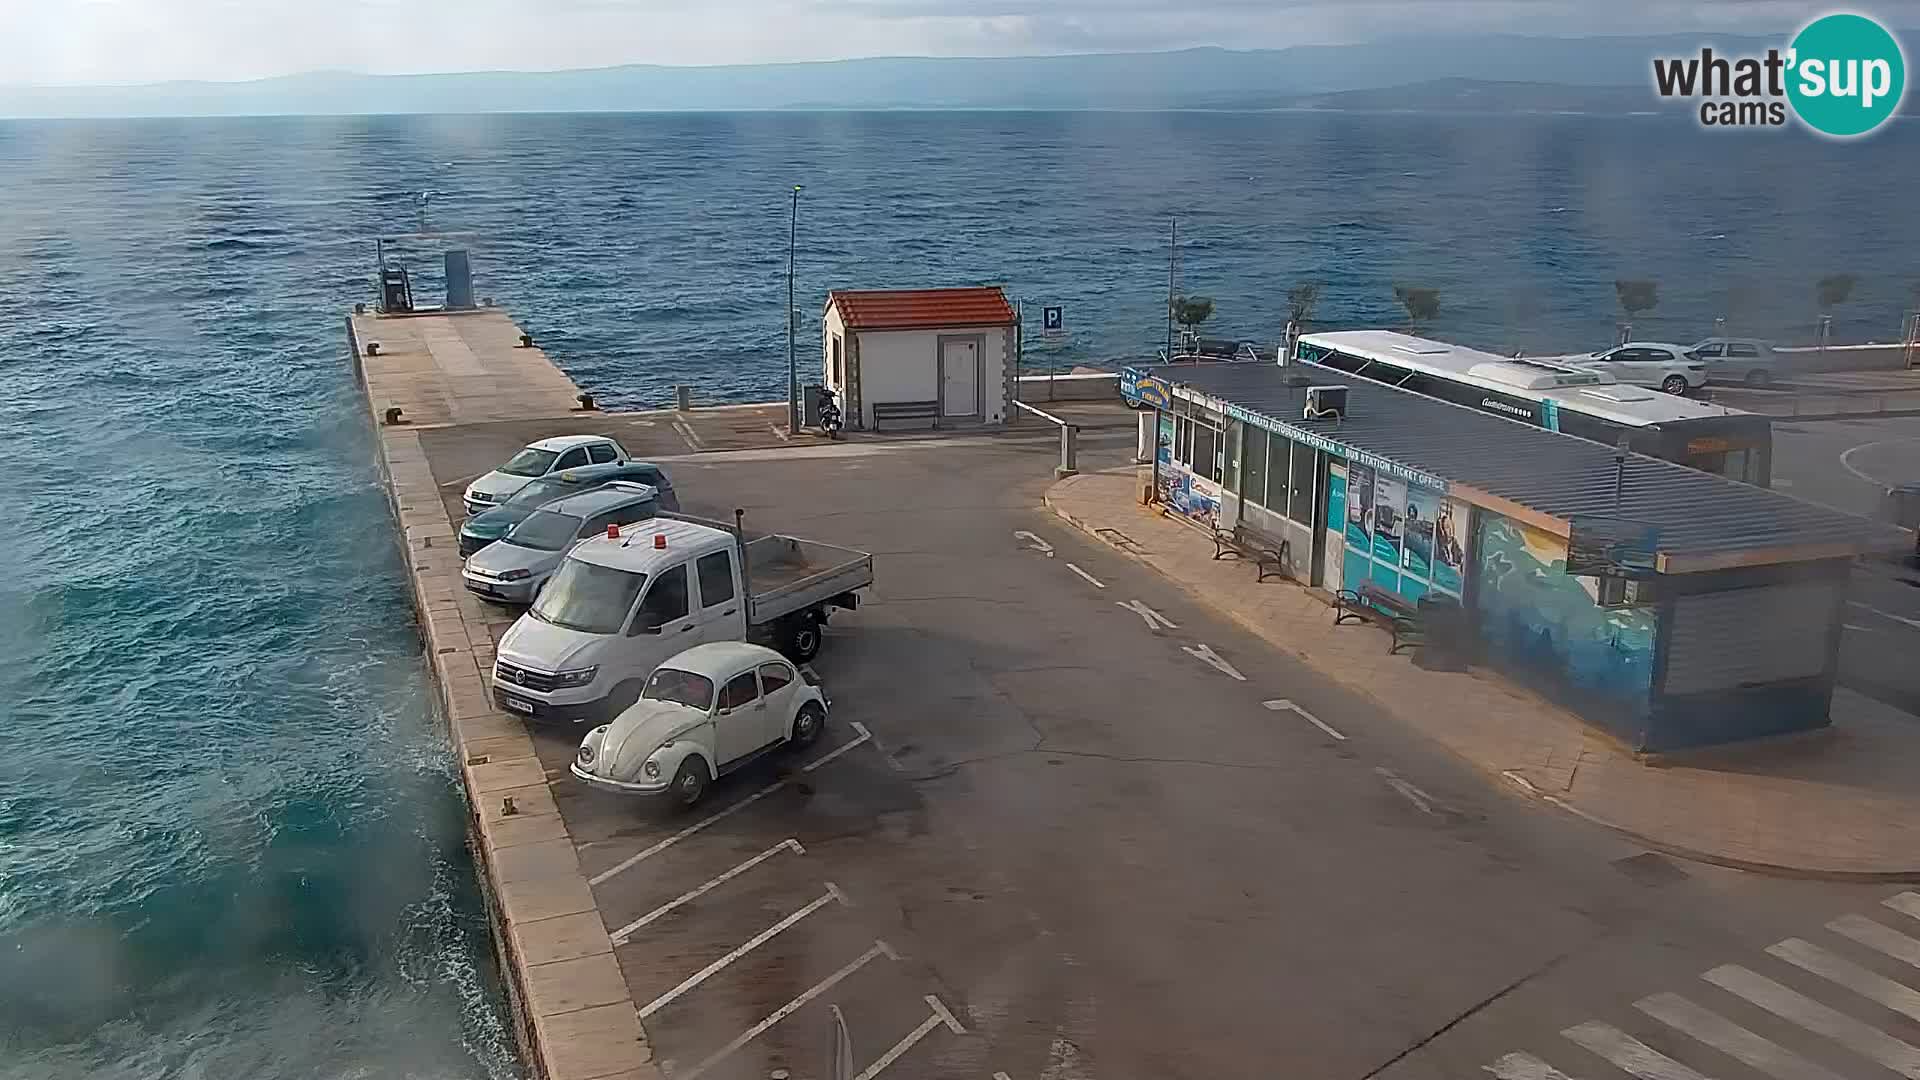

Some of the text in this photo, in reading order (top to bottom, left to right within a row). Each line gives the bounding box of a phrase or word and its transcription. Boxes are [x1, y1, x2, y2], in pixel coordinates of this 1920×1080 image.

[1048, 309, 1058, 326] P
[1269, 421, 1306, 442] AUTOBUSNA
[1306, 435, 1336, 453] POSTAJA
[1345, 447, 1359, 461] BUS
[1360, 454, 1391, 472] STATION
[1392, 464, 1417, 481] TICKET
[1418, 474, 1445, 490] OFFICE
